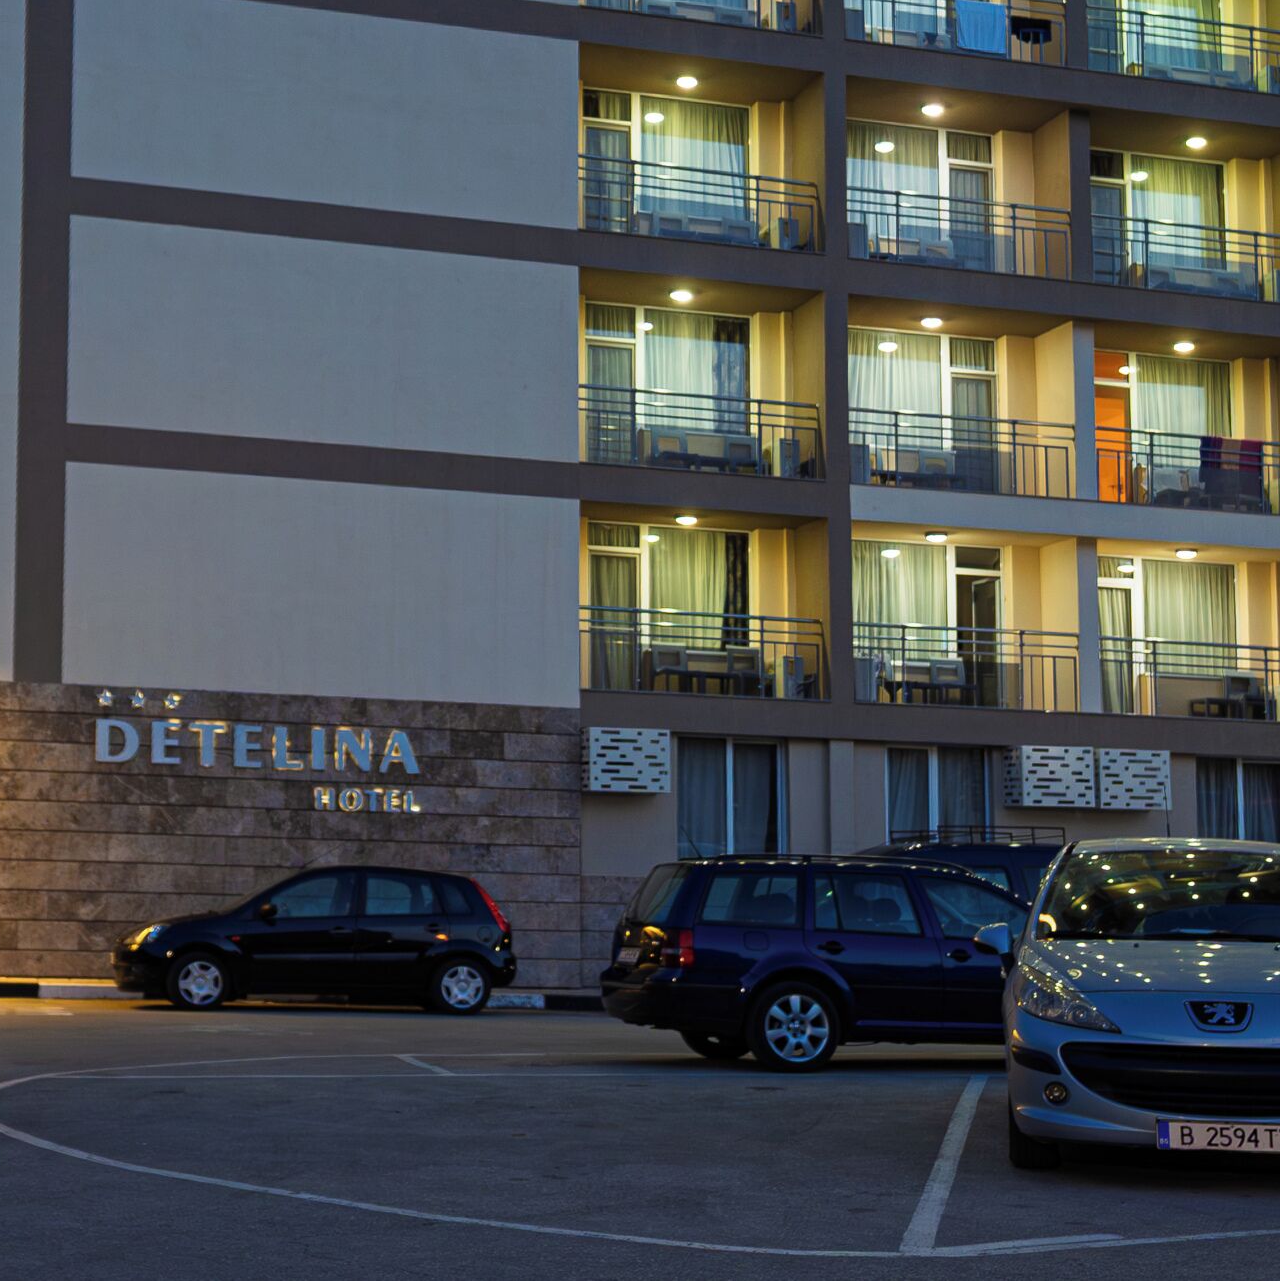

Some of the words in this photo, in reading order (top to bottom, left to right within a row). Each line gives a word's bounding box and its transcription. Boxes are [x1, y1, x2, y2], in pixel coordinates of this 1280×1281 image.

[94, 718, 421, 775] DETELINA
[314, 787, 421, 814] HOTEL
[1179, 1125, 1194, 1146] B
[1206, 1127, 1260, 1149] 2594
